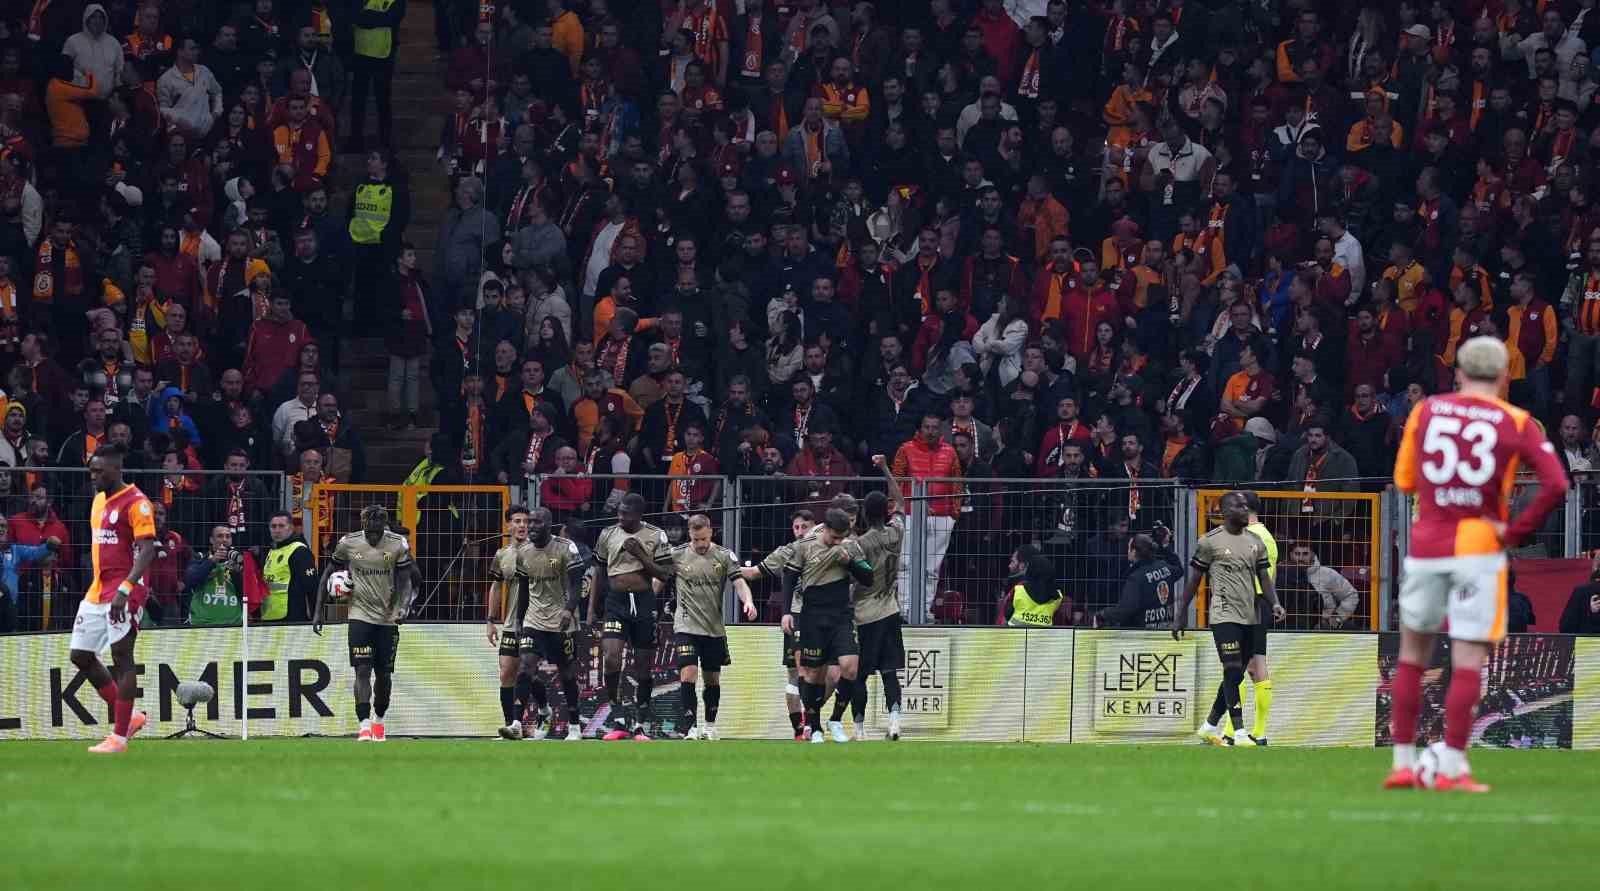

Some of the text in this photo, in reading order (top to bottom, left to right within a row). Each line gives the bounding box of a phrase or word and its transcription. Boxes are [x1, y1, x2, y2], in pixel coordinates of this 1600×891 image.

[1422, 416, 1498, 486] 53
[907, 650, 941, 668] EXT
[1120, 653, 1182, 672] NEXT
[897, 669, 943, 688] EVEL
[1104, 672, 1186, 692] LEVEL
[907, 697, 940, 712] MER
[1106, 700, 1183, 714] KEMER
